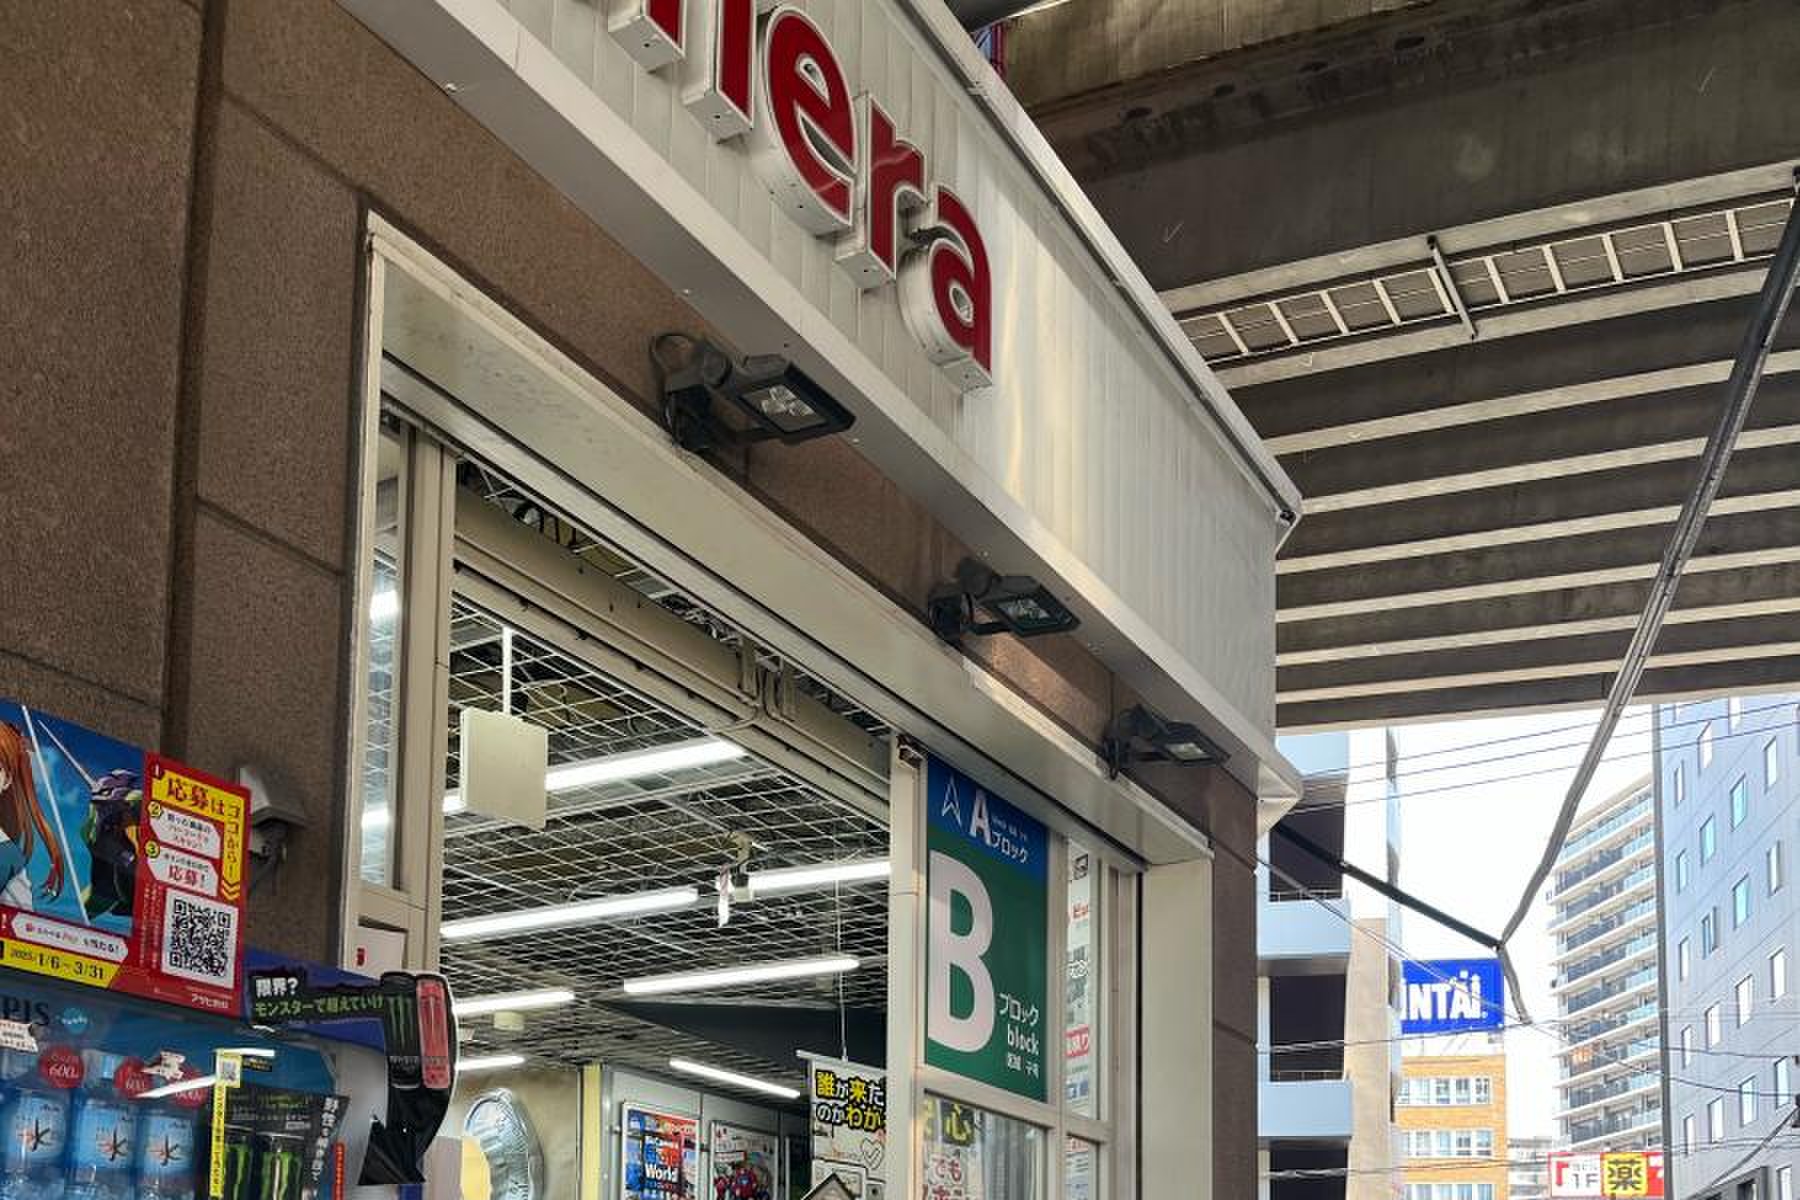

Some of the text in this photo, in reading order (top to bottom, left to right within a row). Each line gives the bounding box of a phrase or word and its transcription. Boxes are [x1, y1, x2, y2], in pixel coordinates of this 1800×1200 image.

[167, 778, 224, 815] 応募は
[929, 849, 995, 1053] B
[254, 977, 299, 999] 限界?
[999, 991, 1040, 1028] ブロック
[1007, 1022, 1040, 1056] block
[815, 1070, 886, 1107] 誰が来た
[645, 1162, 679, 1184] World
[1608, 1158, 1642, 1191] 薬
